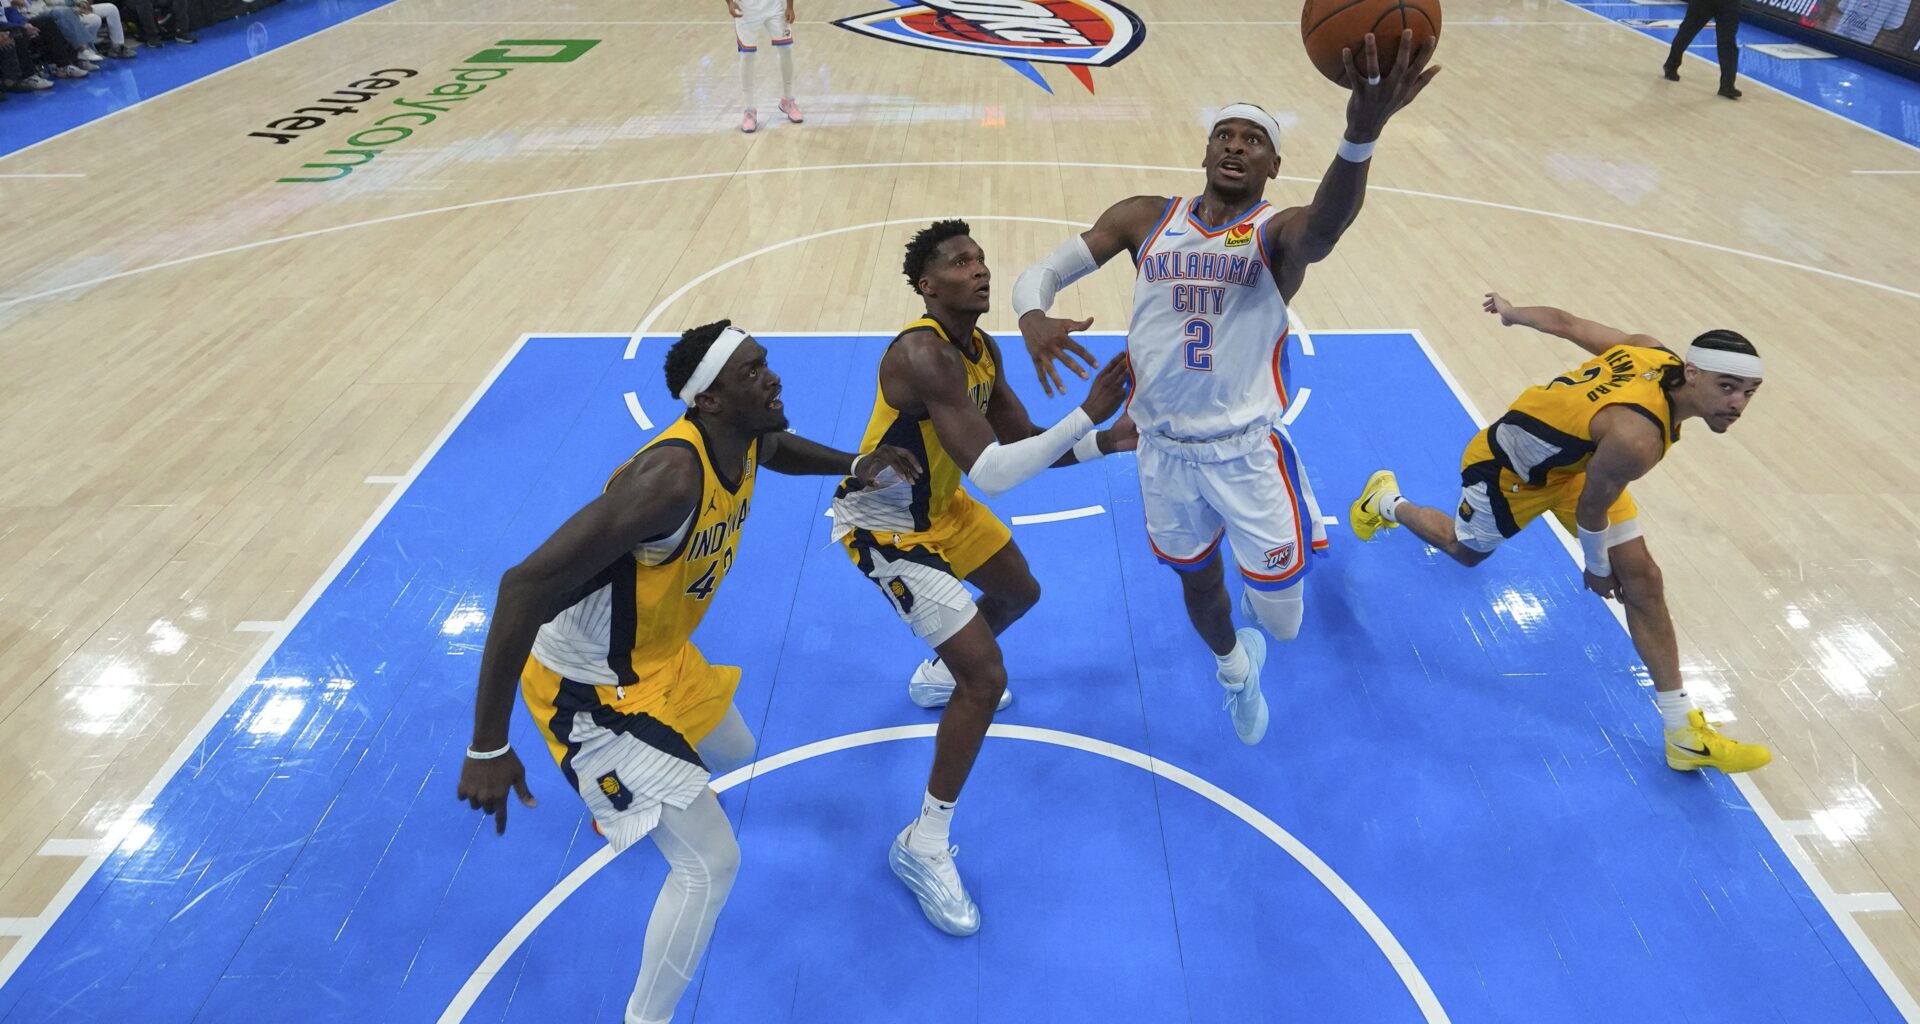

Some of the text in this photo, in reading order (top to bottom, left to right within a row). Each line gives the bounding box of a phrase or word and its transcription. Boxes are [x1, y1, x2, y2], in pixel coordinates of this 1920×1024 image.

[247, 67, 419, 146] center
[275, 68, 514, 184] paycom
[1143, 251, 1264, 288] OKLAHOMA
[1172, 283, 1226, 315] CITY
[1184, 317, 1214, 372] 2
